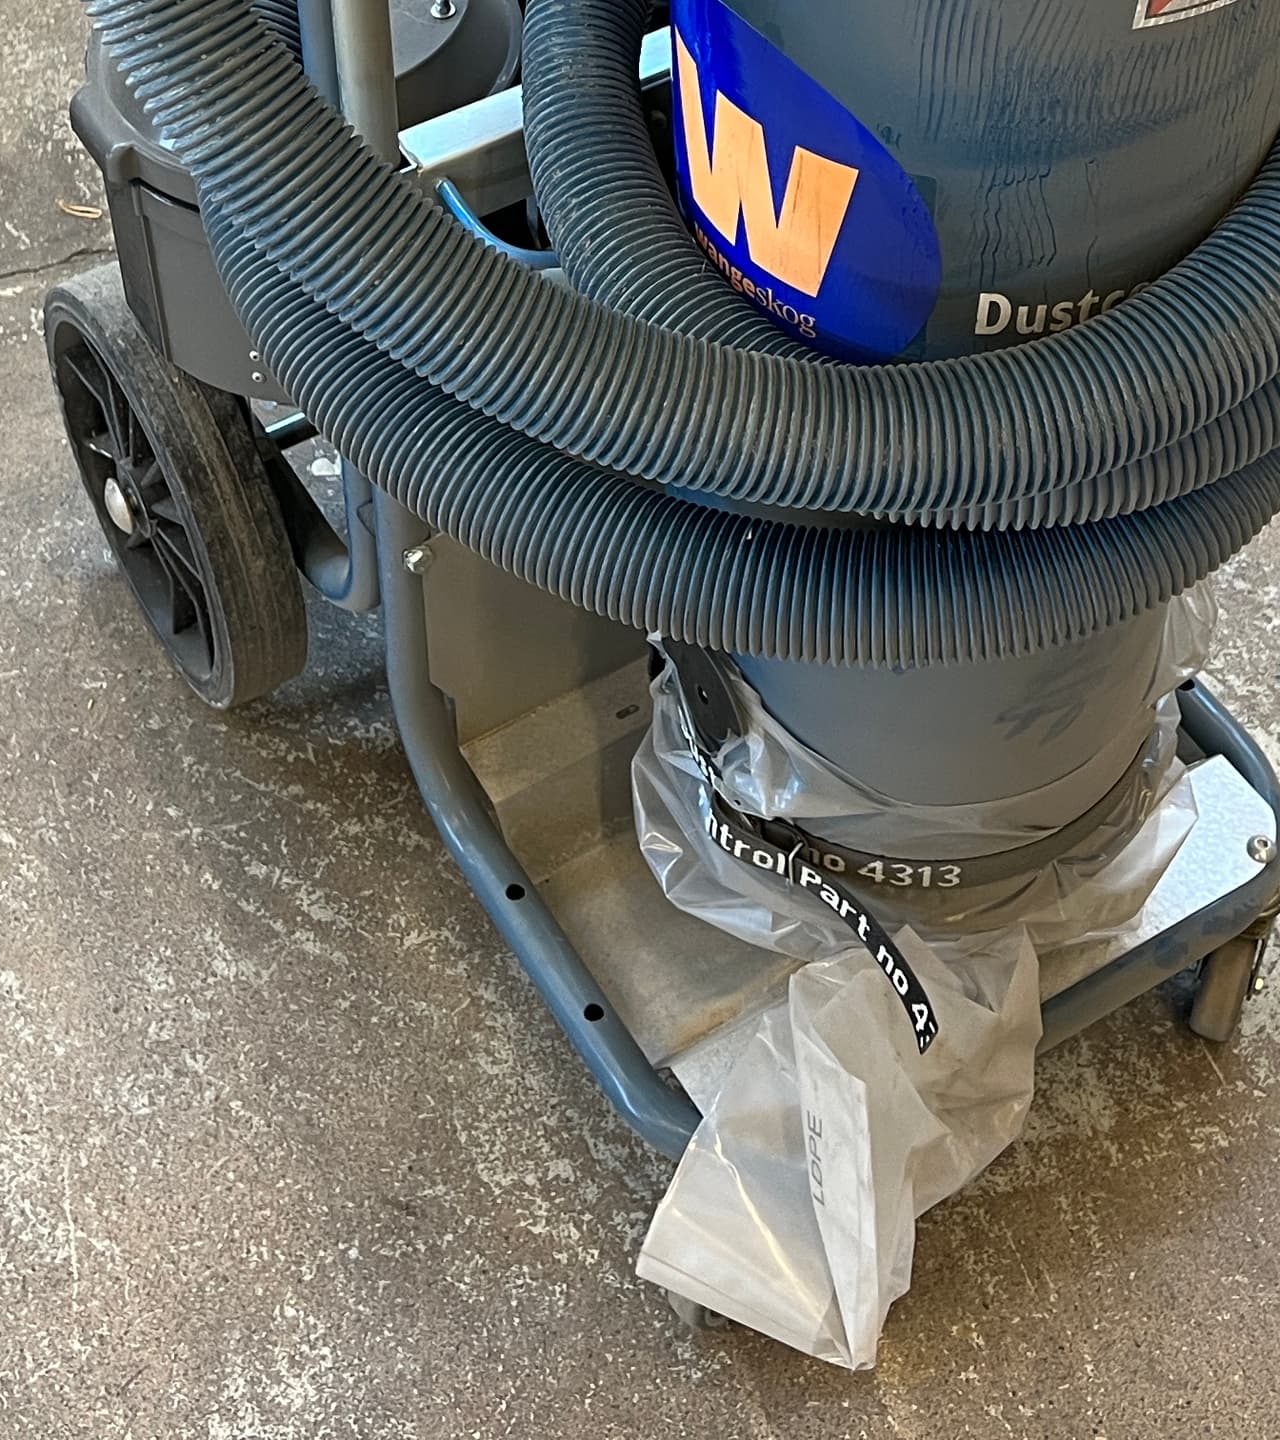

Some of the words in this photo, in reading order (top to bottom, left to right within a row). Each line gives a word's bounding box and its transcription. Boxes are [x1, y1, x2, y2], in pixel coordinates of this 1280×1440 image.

[674, 23, 860, 298] W
[694, 221, 817, 339] wangeskog
[974, 282, 1153, 337] Dustc
[857, 859, 962, 888] 4313
[799, 866, 870, 941] Part
[876, 945, 910, 996] no
[806, 1109, 825, 1206] LDPE
